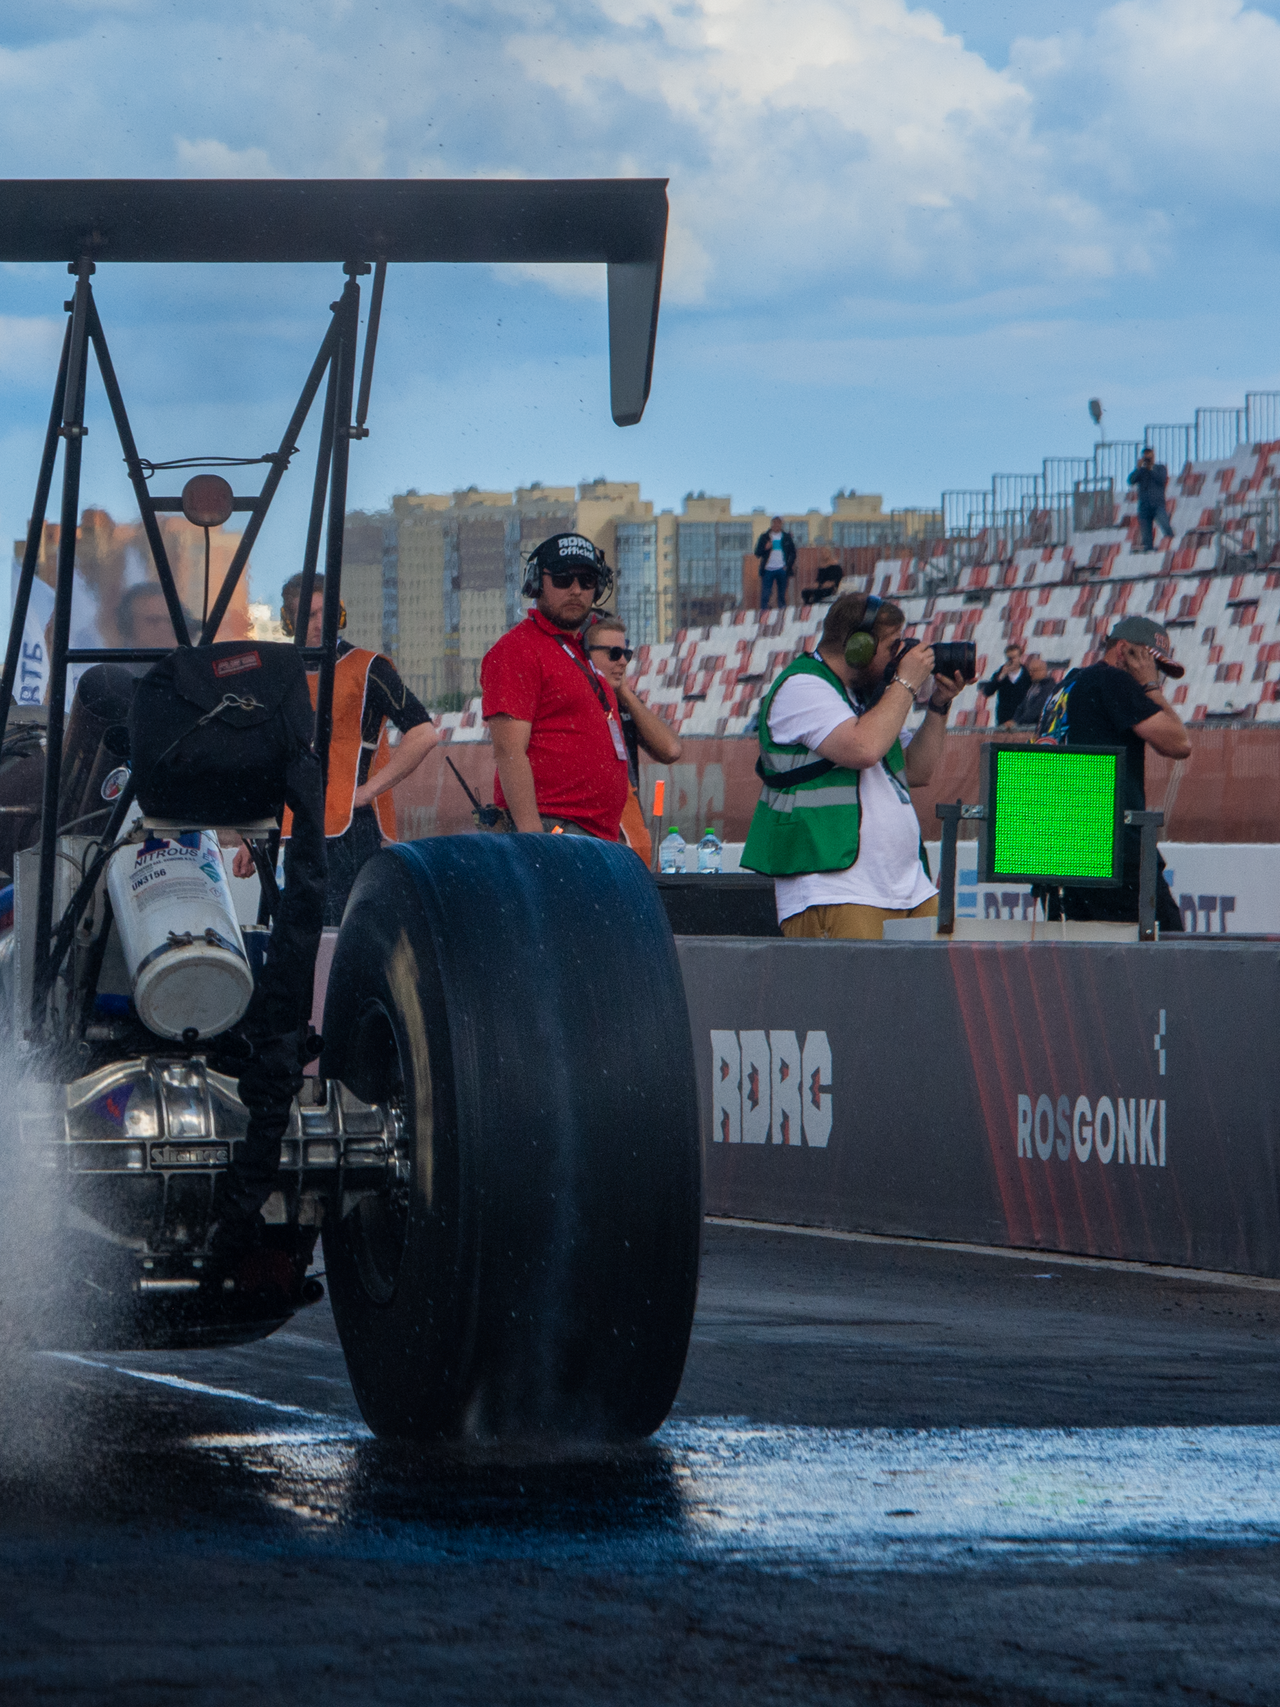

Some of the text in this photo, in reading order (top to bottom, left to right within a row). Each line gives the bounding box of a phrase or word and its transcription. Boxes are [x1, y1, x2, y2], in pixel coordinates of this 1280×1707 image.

[131, 868, 167, 891] UN3156
[135, 847, 198, 869] NITROUS
[710, 1029, 832, 1147] RDRC
[1017, 1093, 1166, 1167] ROSGONKI
